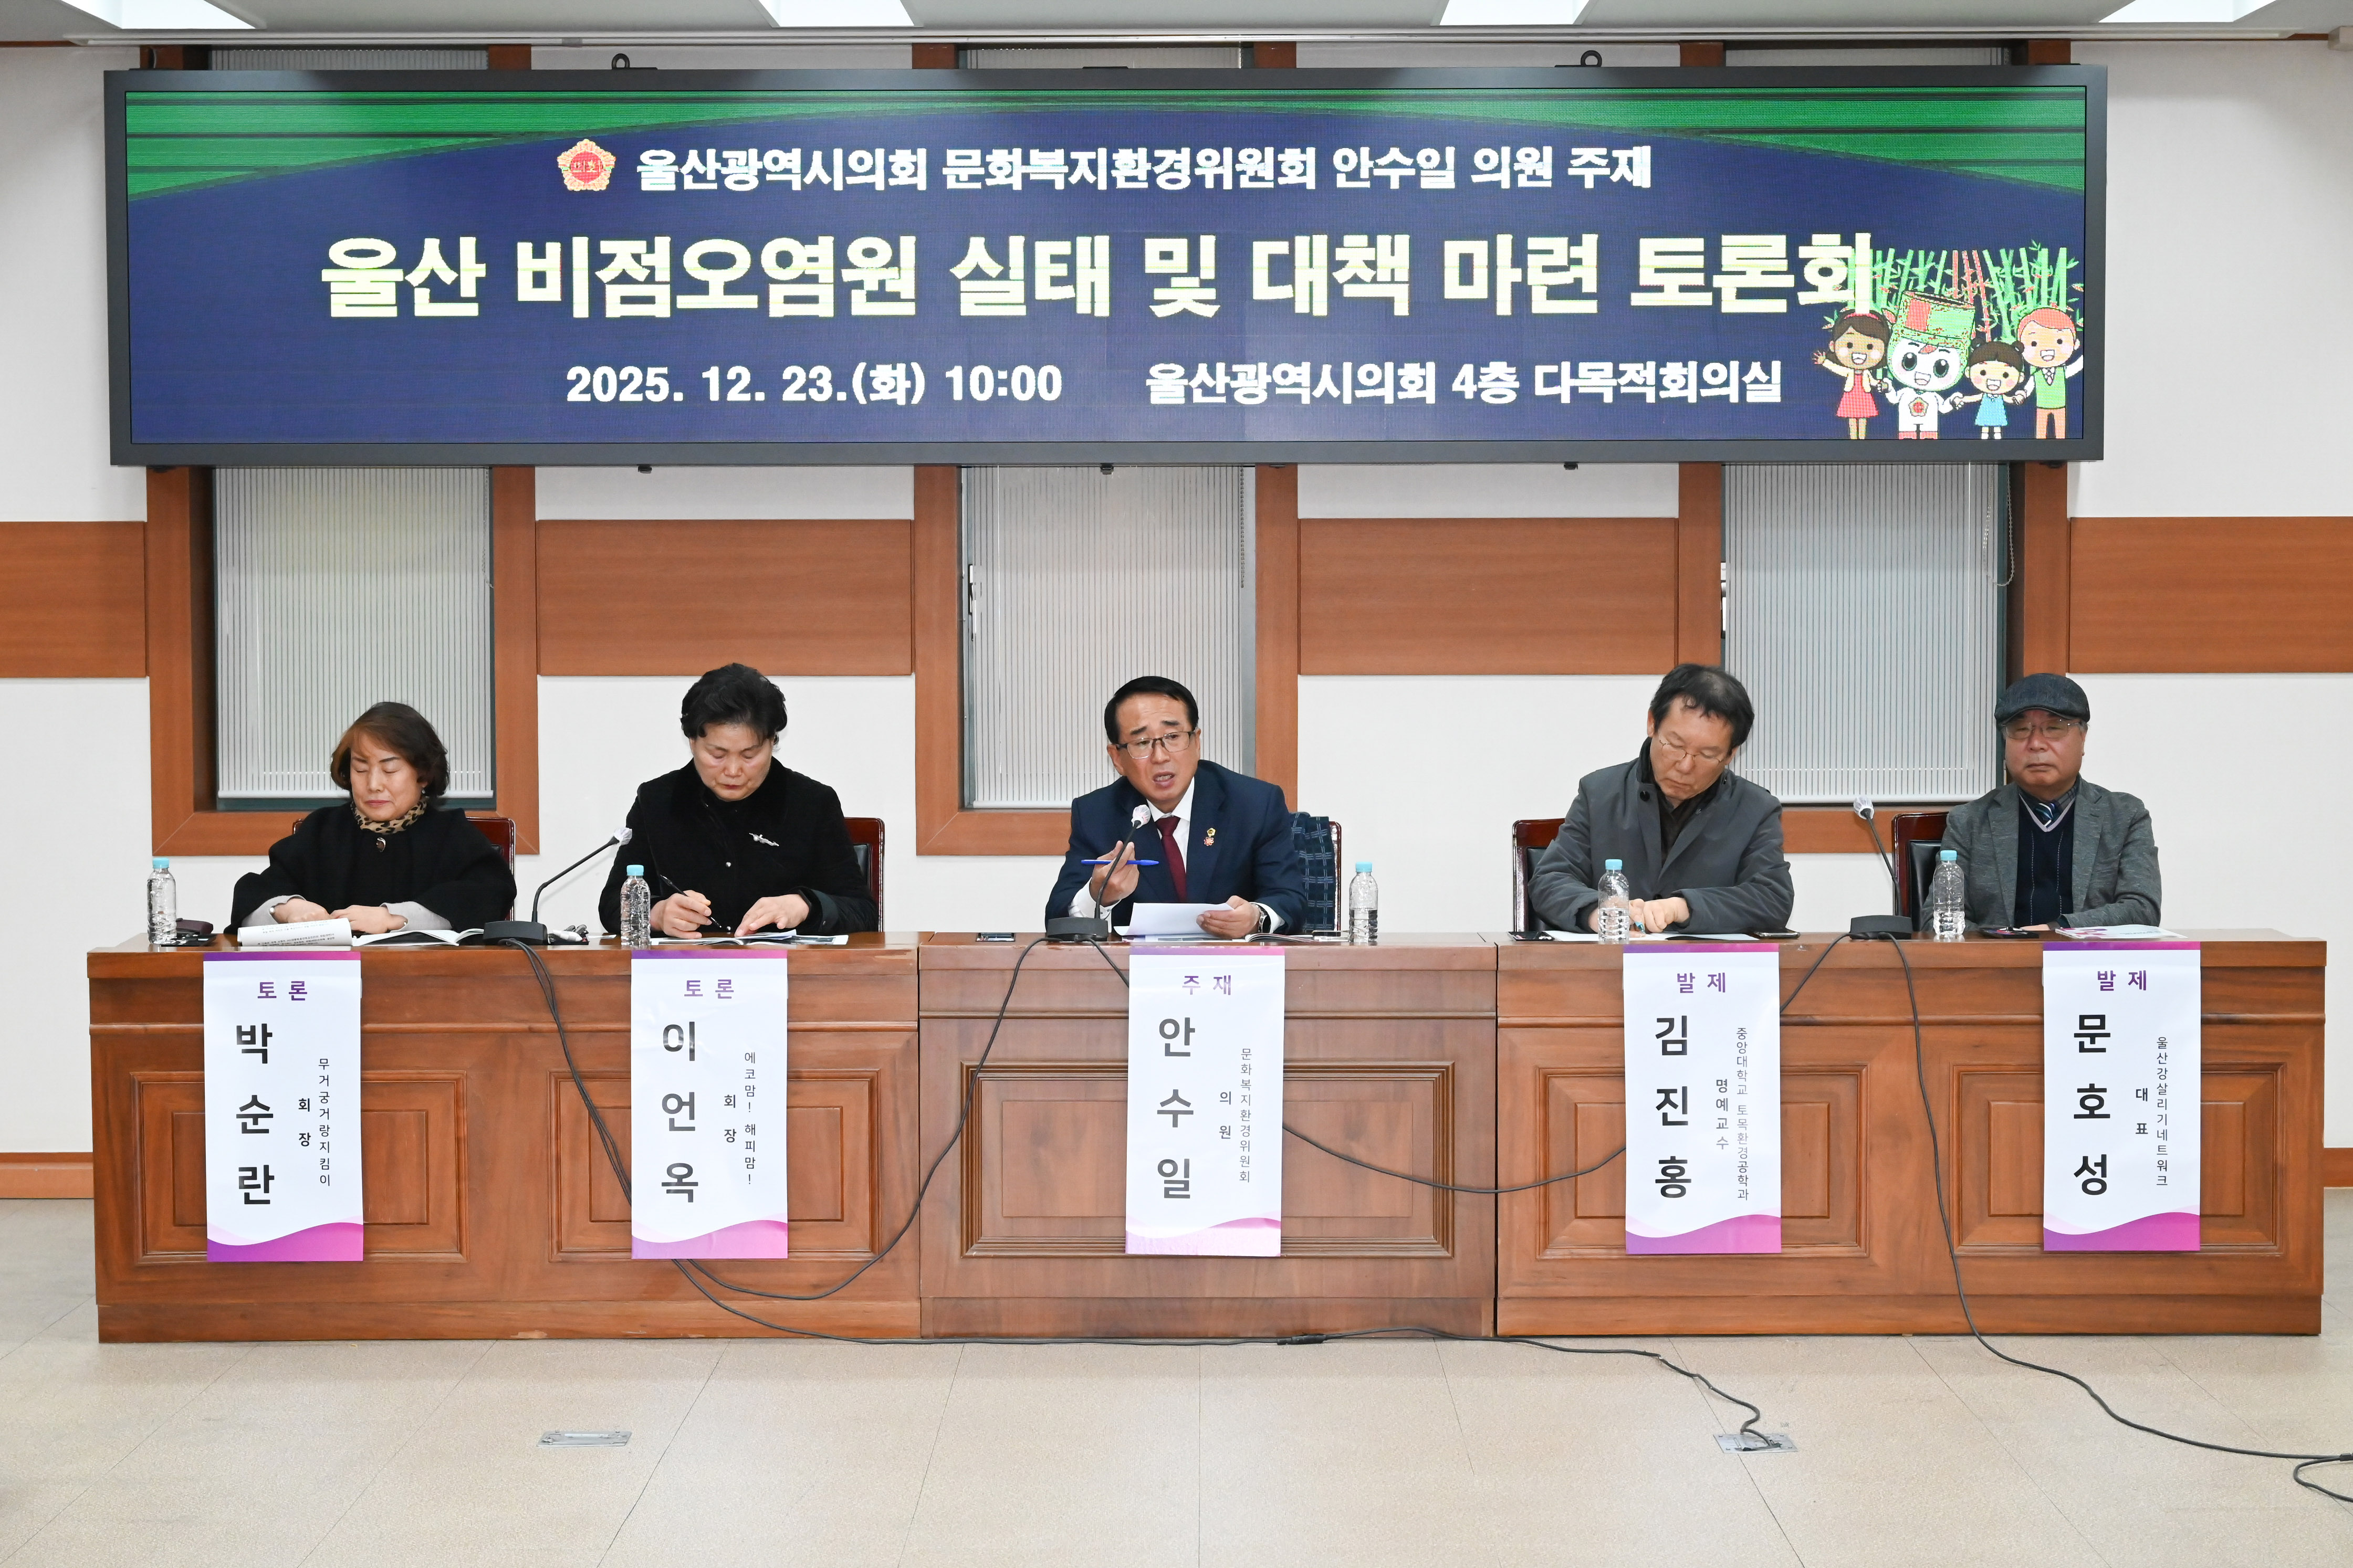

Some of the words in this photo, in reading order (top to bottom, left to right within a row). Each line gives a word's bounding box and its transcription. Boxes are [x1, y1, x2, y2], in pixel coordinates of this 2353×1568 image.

[637, 149, 926, 191] 울산광역시의회
[943, 147, 1315, 190] 문화복지환경위원회
[1333, 146, 1455, 189] 안수일
[1471, 146, 1552, 188] 의원
[1568, 146, 1650, 188] 주재
[322, 237, 486, 317] 울산
[518, 236, 916, 318] 비점오염원
[950, 236, 1109, 317] 실태
[1145, 235, 1220, 317] 및
[1253, 235, 1409, 315] 대책
[1445, 234, 1598, 315] 마련
[1631, 233, 1871, 314] 토론회
[567, 366, 683, 402] 2025.
[703, 366, 765, 401] 12.
[783, 362, 925, 405] 23.(화)
[946, 365, 1062, 401] 10:00
[1146, 362, 1435, 404] 울산광역시의회
[1452, 362, 1519, 404] 4층
[1535, 361, 1781, 403] 다목적회의실
[744, 1051, 756, 1110] 에코맘!
[1736, 1027, 1748, 1095] 중앙대학교
[318, 1058, 331, 1187] 무거궁거랑지킴이
[1239, 1048, 1252, 1183] 문화복지환경위원회
[1716, 1078, 1729, 1150] 명예교수
[2156, 1036, 2168, 1186] 울산강살리기네트워크
[744, 1123, 756, 1182] 해피맘!
[1737, 1105, 1749, 1201] 토목환경공학과
